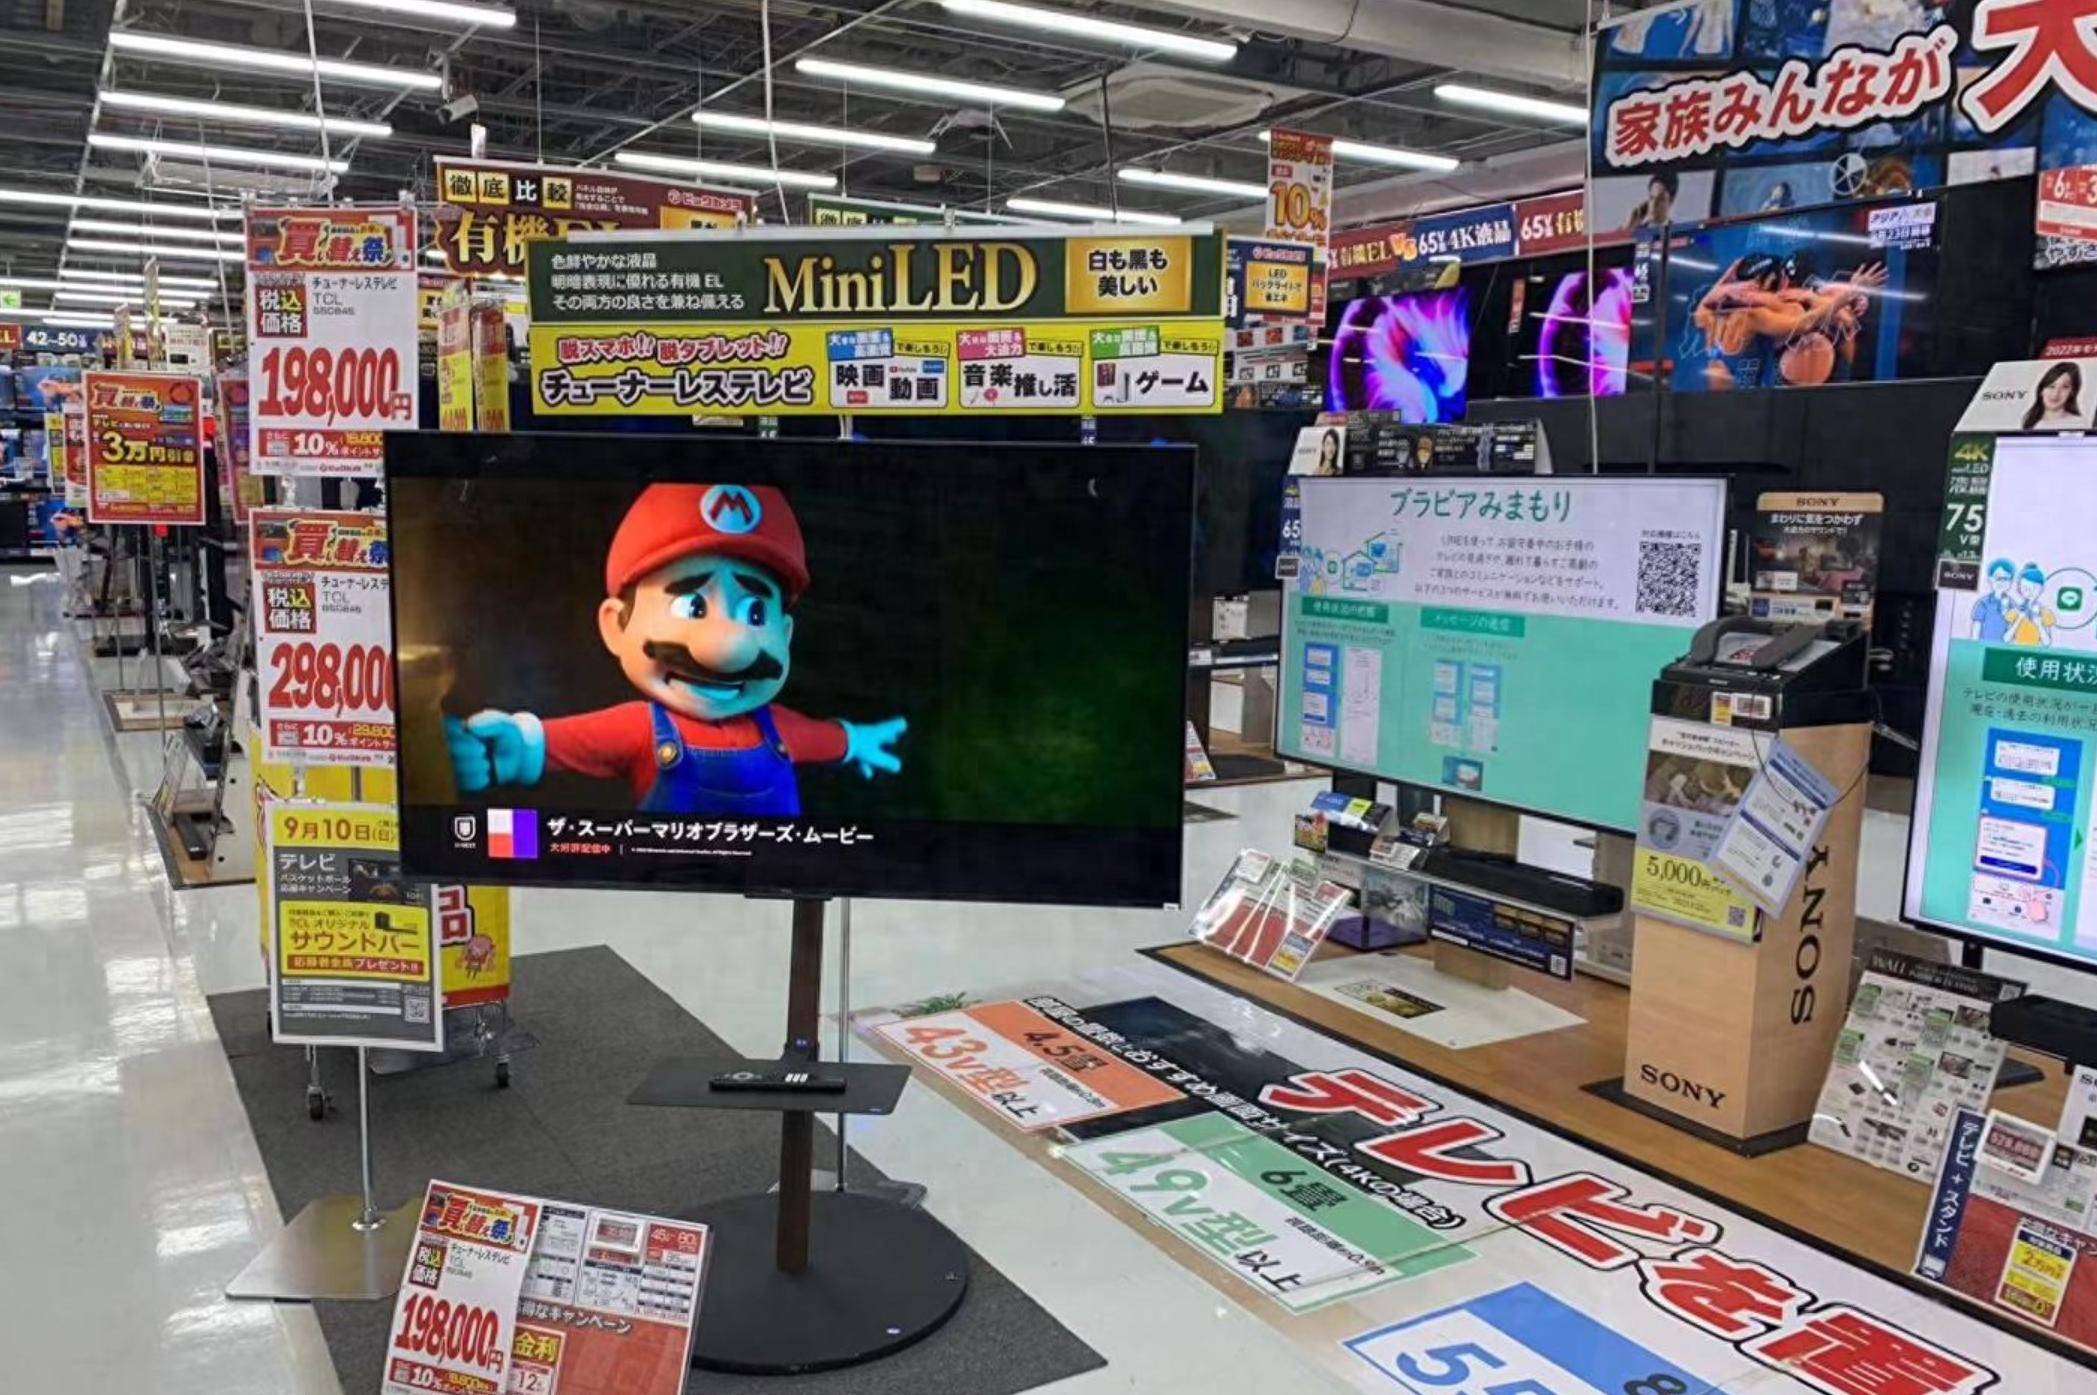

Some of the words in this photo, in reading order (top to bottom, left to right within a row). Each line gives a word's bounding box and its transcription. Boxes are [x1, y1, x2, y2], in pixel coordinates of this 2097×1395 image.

[1612, 38, 1947, 157] 家族みんなが
[449, 170, 571, 206] 徹底比較
[1269, 181, 1328, 231] 10%
[551, 253, 657, 271] 色鮮やかな液晶
[1088, 247, 1168, 272] 白も黒も
[312, 276, 397, 290] チューナーレステレビ
[551, 273, 701, 290] 明暗表現に優れる有機
[704, 274, 724, 289] EL
[762, 242, 1039, 314] MiniLED
[1268, 269, 1287, 278] LED
[1097, 275, 1159, 298] 美しい
[259, 289, 302, 313] 税込
[313, 292, 342, 306] TCL
[552, 293, 745, 311] その両方の良さを兼ね備える
[260, 312, 302, 334] 価格
[258, 346, 412, 427] 198,000円
[543, 370, 813, 404] チューナーレステレビ
[836, 364, 884, 387] 映画
[963, 364, 1013, 387] 音楽
[1014, 372, 1077, 398] 推し活
[1135, 370, 1210, 395] ゲーム
[889, 376, 939, 401] 動画
[1982, 390, 2028, 401] SONY
[293, 432, 338, 457] 10%
[1954, 442, 1989, 462] 4K
[1390, 488, 1573, 523] ブラビアみまもり
[1796, 497, 1840, 507] SONY
[1945, 503, 1985, 533] 75
[267, 587, 311, 609] 税込
[321, 590, 351, 603] TCL
[269, 609, 311, 630] 価格
[302, 724, 348, 747] 10%
[547, 816, 874, 846] ザ・スーパーマリオブラザーズ・ムービー
[279, 853, 337, 872] テレビ
[279, 874, 352, 884] バスケットボール
[290, 931, 420, 953] サウンドバー
[1790, 845, 1830, 1026] SONY
[1640, 1063, 1727, 1110] SONY
[1259, 1168, 1348, 1213] 6畳
[1934, 1190, 1962, 1249] スタンド
[393, 1293, 505, 1375] 198,000円
[515, 1330, 557, 1362] 金利
